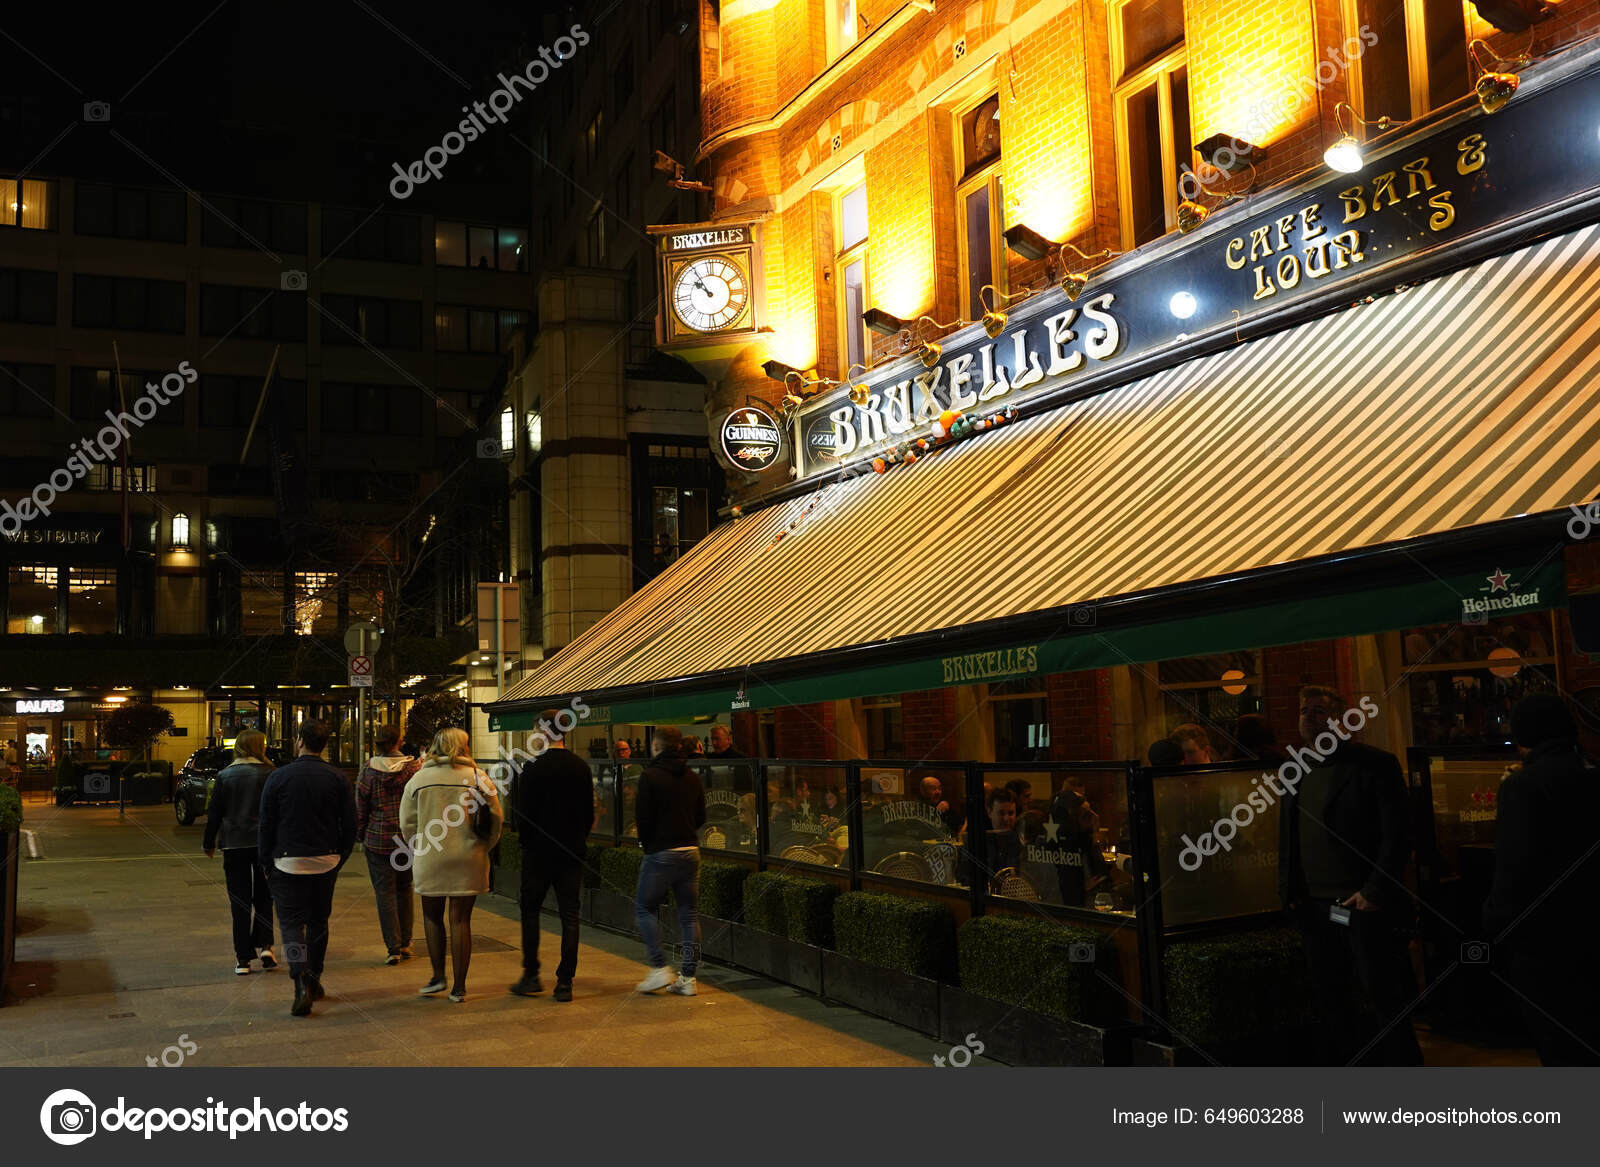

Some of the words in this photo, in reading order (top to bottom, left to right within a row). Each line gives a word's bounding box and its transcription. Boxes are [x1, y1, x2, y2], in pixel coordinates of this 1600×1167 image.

[1225, 203, 1328, 269] CAFE
[1339, 156, 1437, 224] BAR
[672, 229, 744, 249] BRUXELLES
[829, 293, 1119, 456] BRUXELLES
[725, 426, 778, 441] GUINNESS
[5, 530, 103, 543] WESTBURY
[1462, 592, 1540, 613] Heineken
[942, 645, 1038, 682] BRUXELLES
[16, 699, 64, 713] BALFES
[1027, 845, 1082, 866] Heineken
